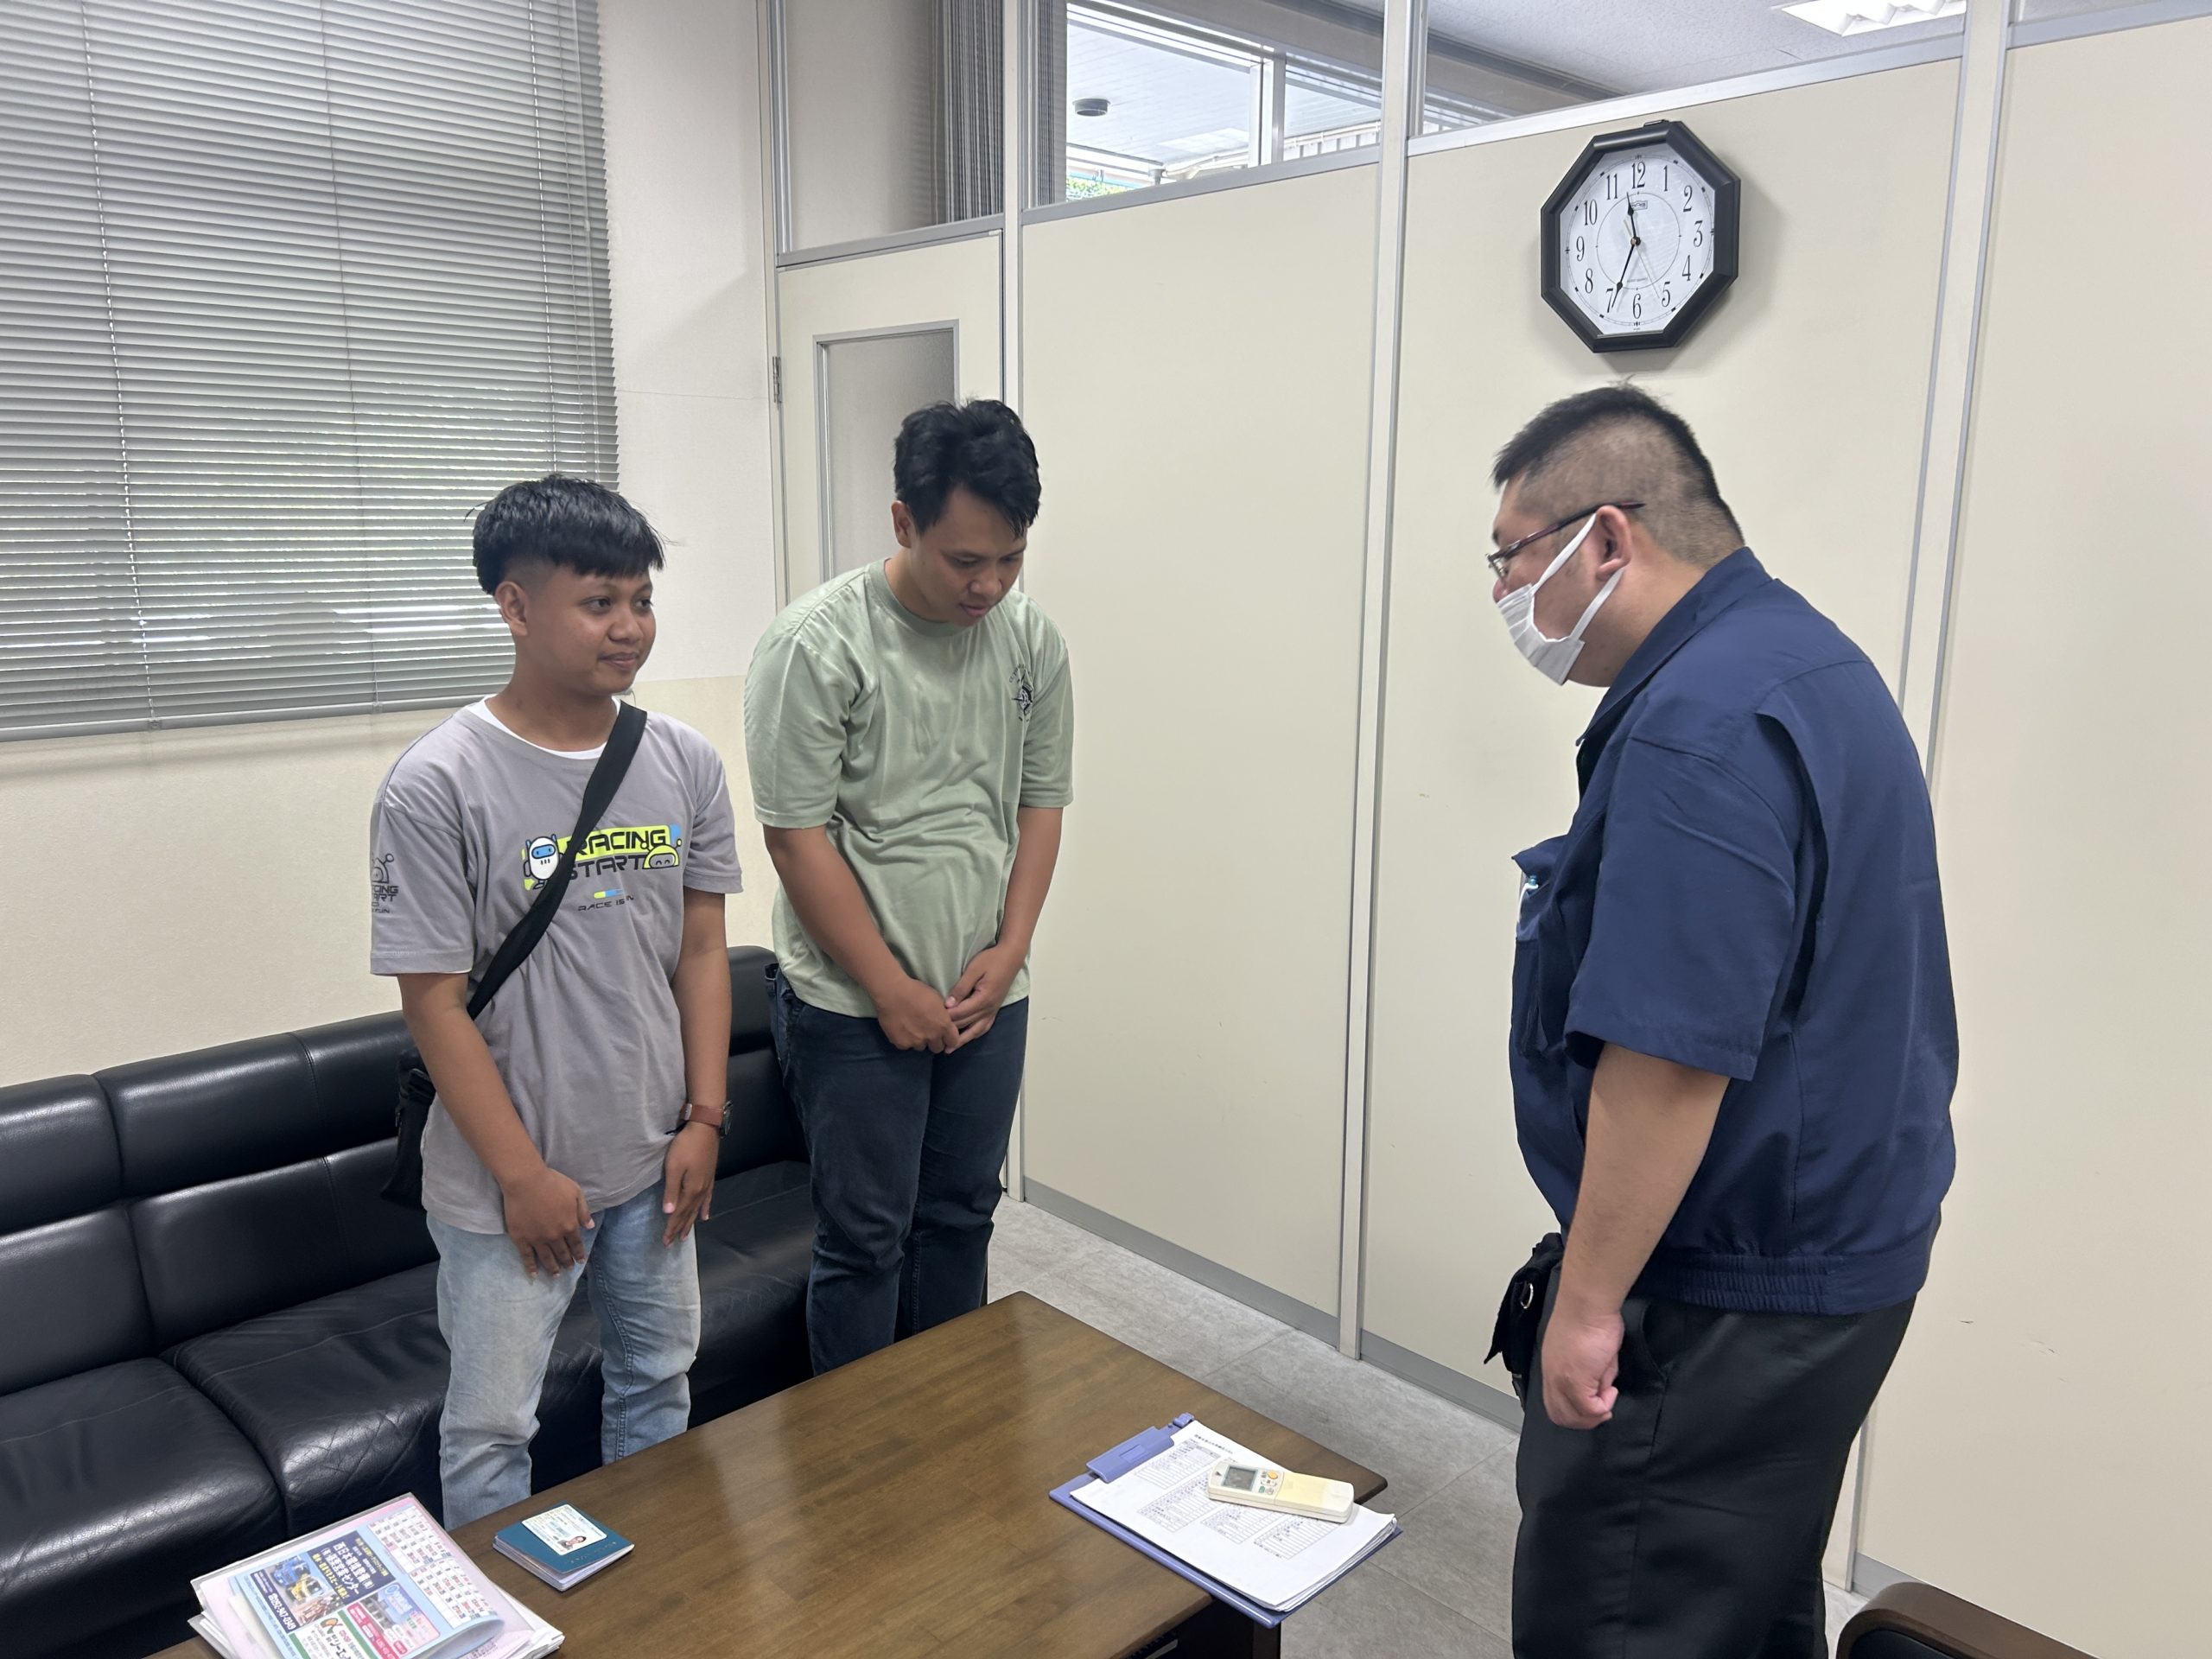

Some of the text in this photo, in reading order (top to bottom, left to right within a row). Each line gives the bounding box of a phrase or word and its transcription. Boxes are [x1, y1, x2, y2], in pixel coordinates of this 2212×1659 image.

[1606, 173, 1618, 200] 11
[1631, 161, 1646, 189] 12
[1662, 165, 1669, 192] 1
[1682, 185, 1693, 212] 2
[1584, 199, 1598, 226] 10
[1693, 220, 1703, 247] 3
[1576, 235, 1585, 262] 9
[1585, 268, 1593, 294] 8
[1681, 255, 1691, 281] 4
[1605, 288, 1614, 313] 7
[1632, 293, 1642, 320] 6
[1661, 281, 1671, 307] 5
[577, 900, 613, 912] RACE
